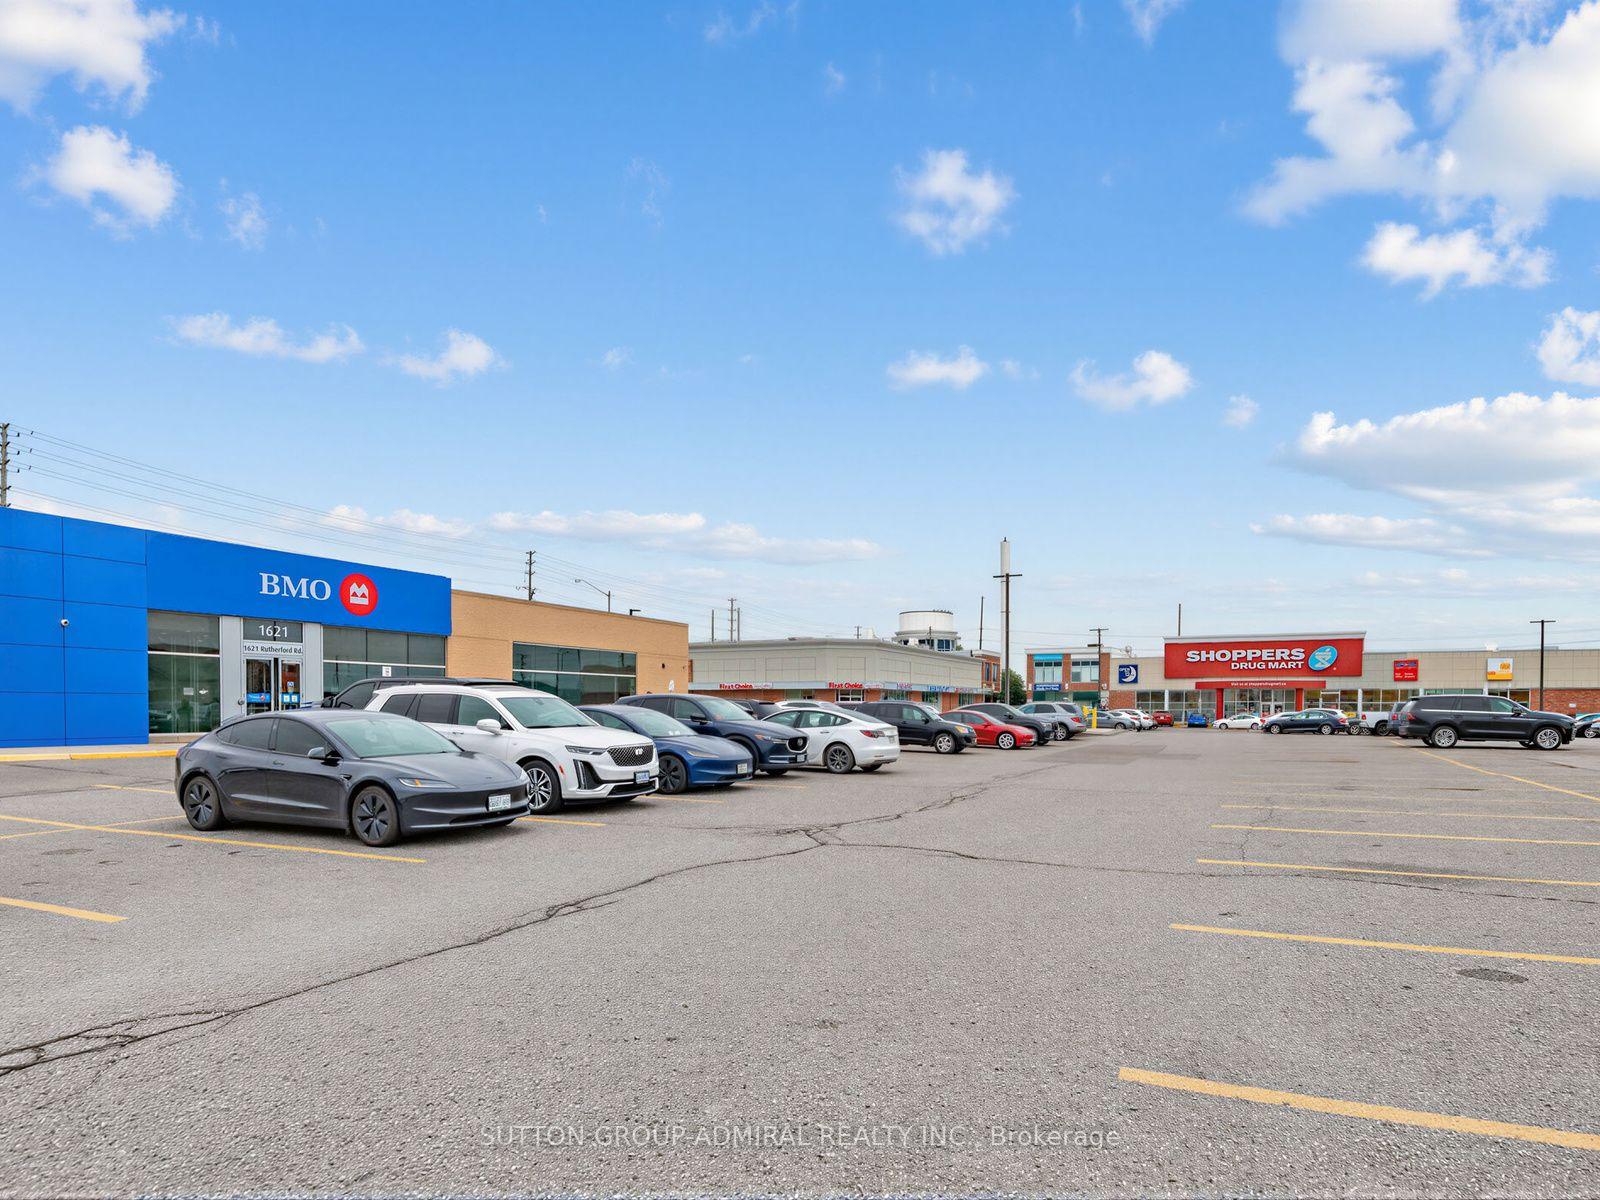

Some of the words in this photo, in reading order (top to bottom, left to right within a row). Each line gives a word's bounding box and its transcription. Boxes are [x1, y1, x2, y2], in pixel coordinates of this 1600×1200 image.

[259, 572, 331, 600] BMO
[259, 625, 288, 637] 1621
[1186, 648, 1306, 662] SHOPPERS
[1231, 662, 1266, 670] DRUG
[1268, 661, 1304, 669] MART
